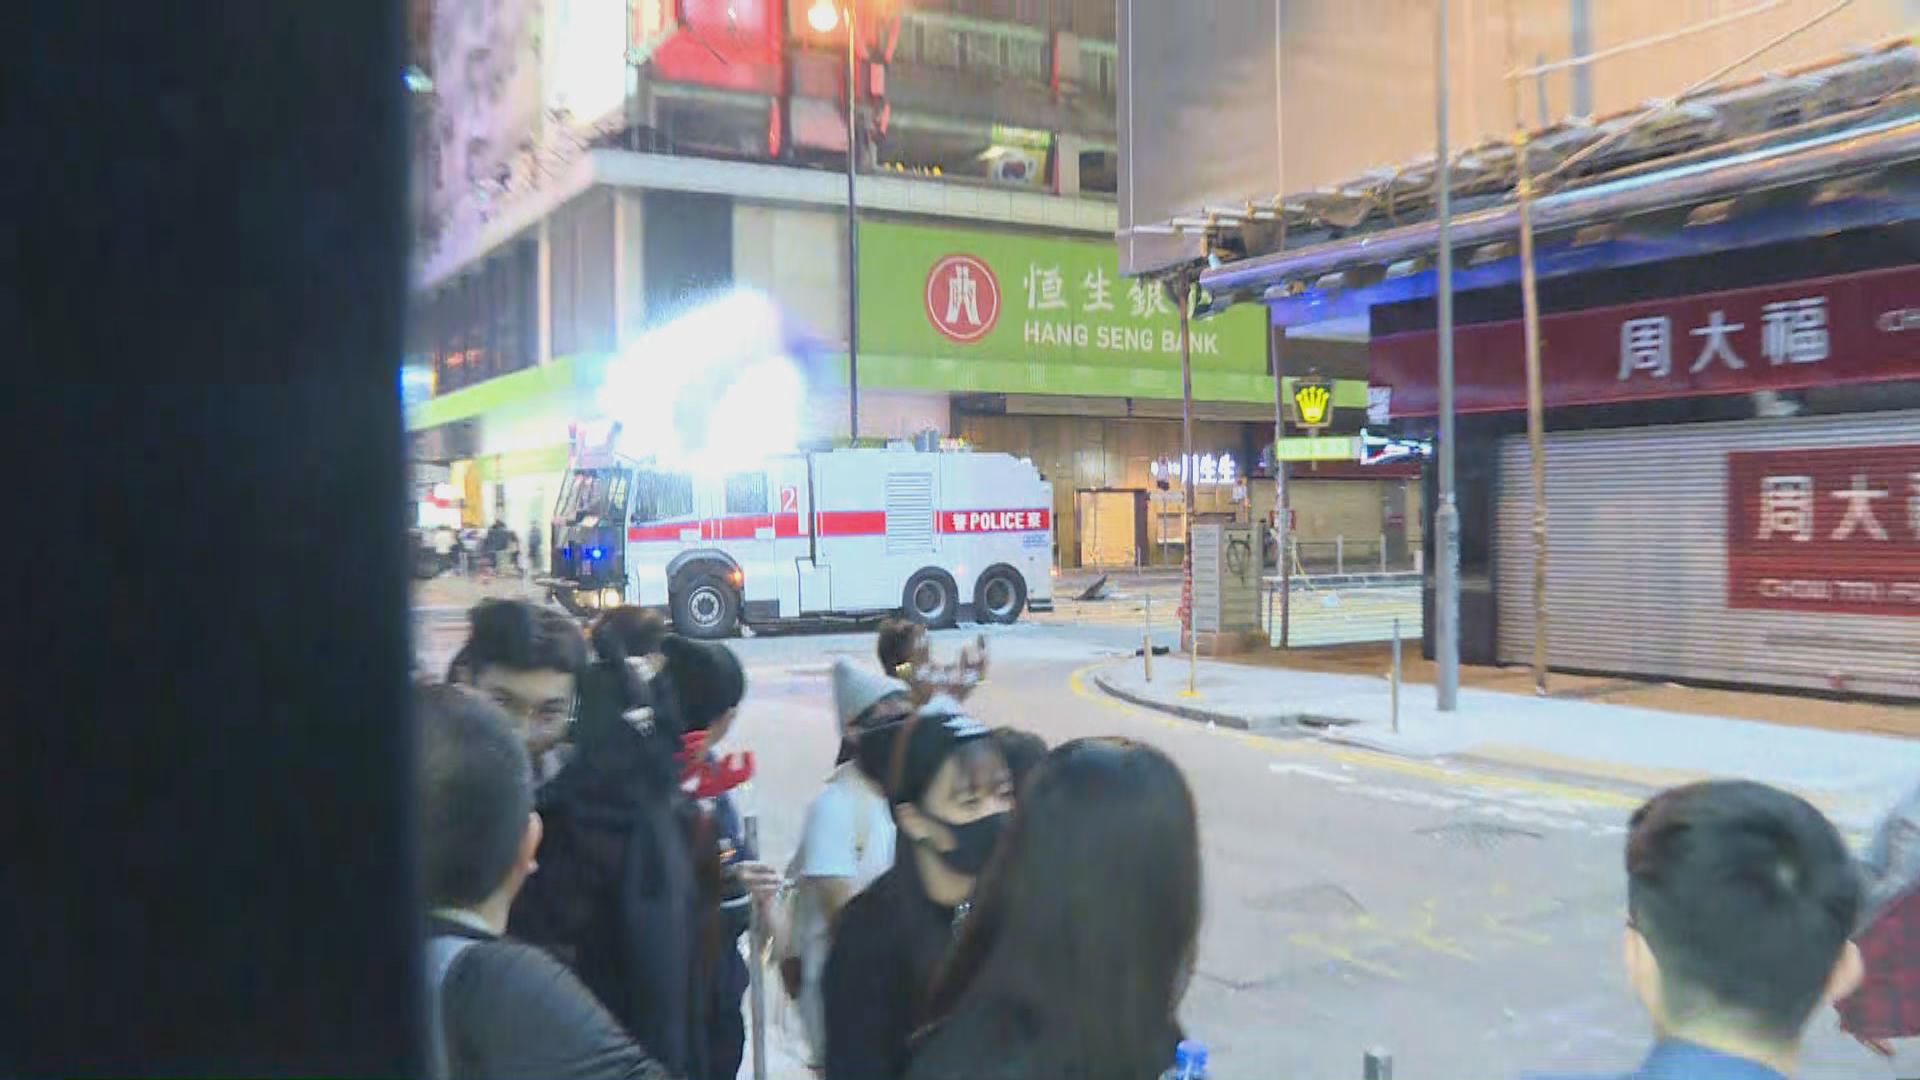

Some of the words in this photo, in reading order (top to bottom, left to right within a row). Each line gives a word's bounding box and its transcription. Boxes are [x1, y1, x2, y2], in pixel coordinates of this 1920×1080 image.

[1024, 320, 1088, 347] HANG
[1096, 326, 1153, 350] SENG
[1617, 296, 1831, 381] 周大福
[782, 487, 797, 512] 2
[970, 511, 1025, 530] POLICE
